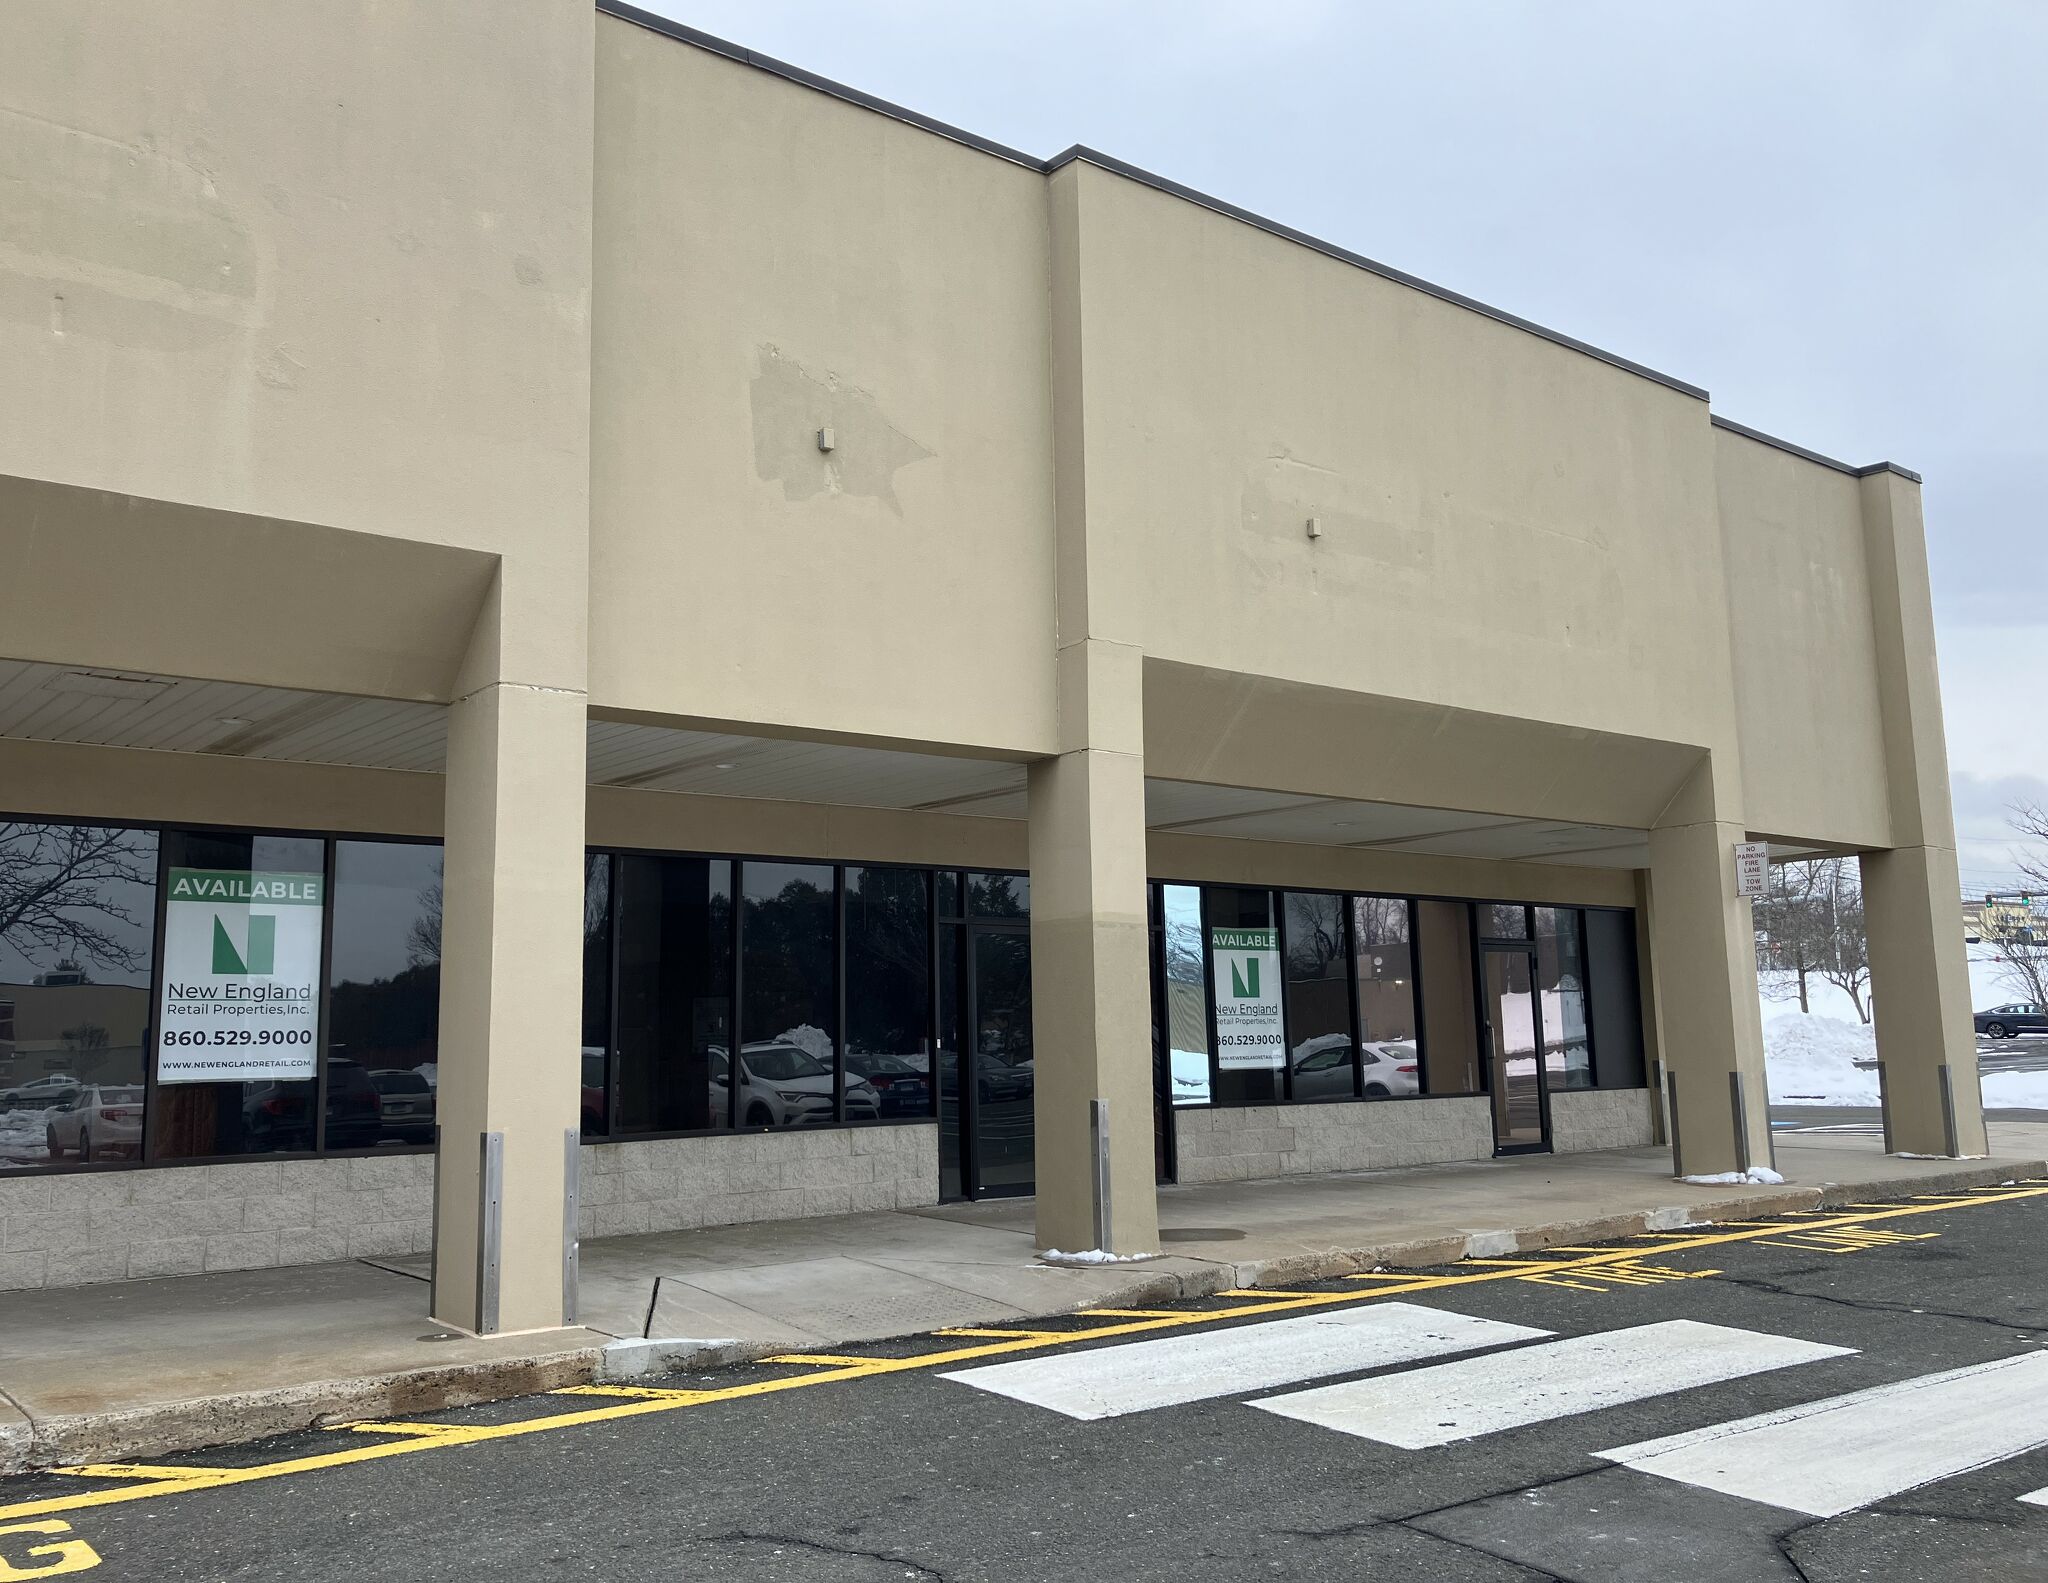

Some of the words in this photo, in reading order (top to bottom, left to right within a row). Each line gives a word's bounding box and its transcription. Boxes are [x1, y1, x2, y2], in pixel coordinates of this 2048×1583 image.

[173, 878, 317, 900] AVAILABLE
[1212, 934, 1276, 947] AVAILABLE
[168, 983, 219, 999] New
[225, 983, 311, 1003] England
[167, 1004, 209, 1014] Retail
[1216, 1004, 1237, 1014] New
[1239, 1003, 1278, 1016] England
[163, 1030, 312, 1046] 860.529.9000
[162, 1060, 311, 1069] WWW.NEWENGLANDRETAIL.COM
[1751, 1226, 1942, 1252] LANE
[1515, 1260, 1724, 1292] FIRE
